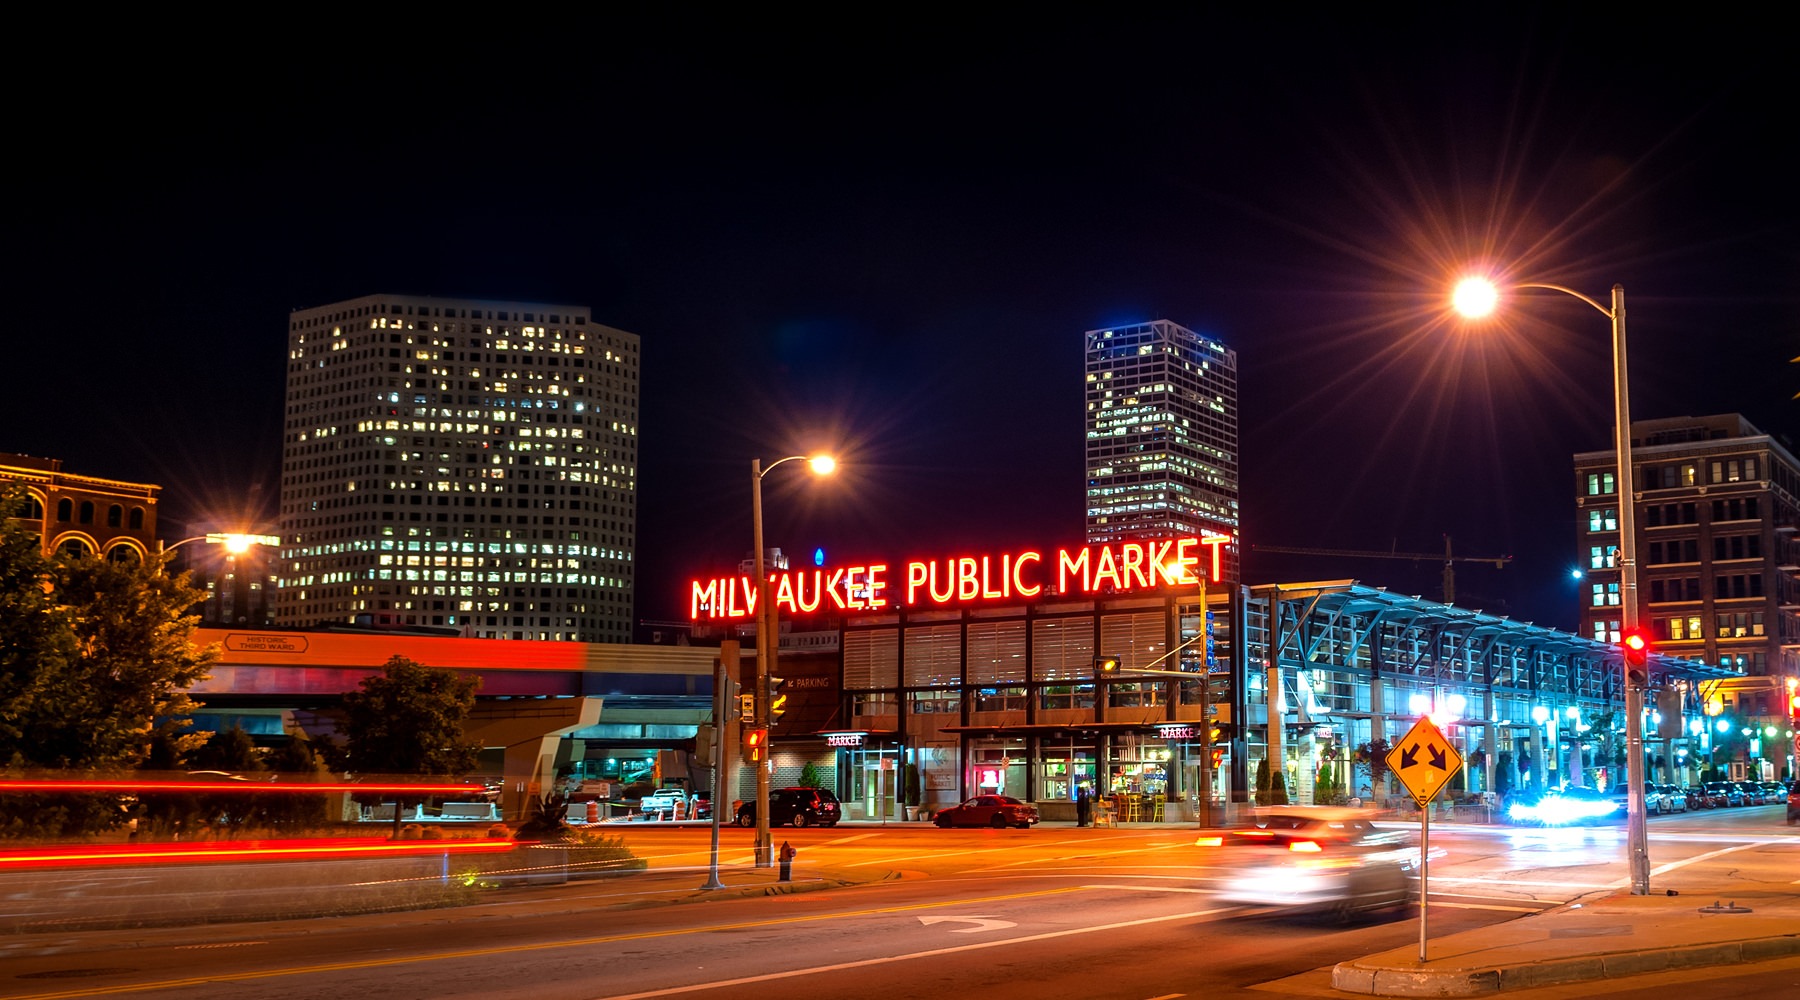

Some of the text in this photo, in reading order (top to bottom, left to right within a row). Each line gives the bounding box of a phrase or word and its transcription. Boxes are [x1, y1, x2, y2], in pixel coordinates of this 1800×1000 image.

[908, 551, 1041, 604] PUBLIC
[1059, 535, 1231, 593] MARKET
[796, 677, 829, 688] PARKING
[827, 735, 861, 746] MARKET
